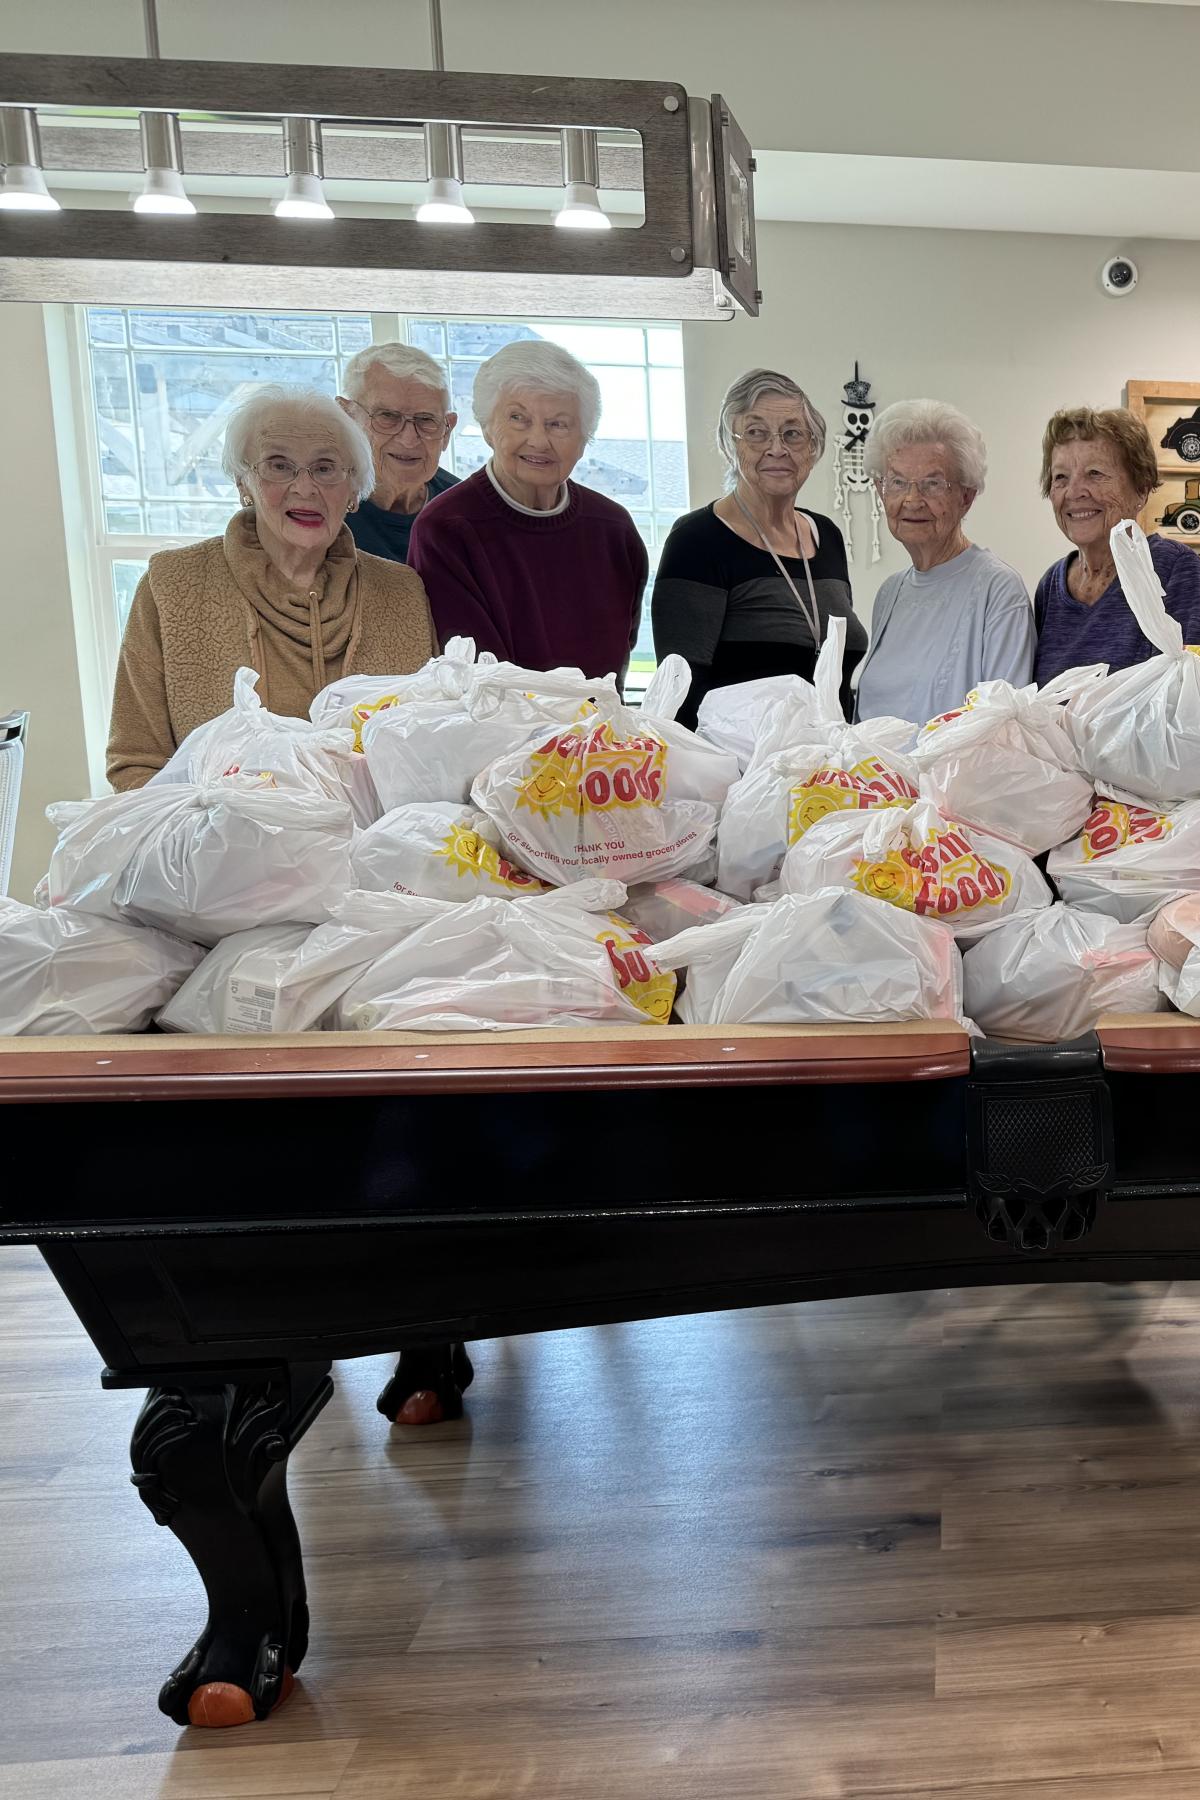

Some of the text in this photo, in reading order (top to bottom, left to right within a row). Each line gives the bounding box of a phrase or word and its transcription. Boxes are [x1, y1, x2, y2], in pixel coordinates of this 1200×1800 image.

[582, 755, 662, 805] oods
[520, 841, 561, 865] suorting
[561, 857, 579, 867] your
[581, 853, 610, 865] locally
[612, 851, 644, 862] owned
[675, 831, 698, 848] stores
[573, 840, 626, 854] THANK YOU
[393, 881, 407, 893] for
